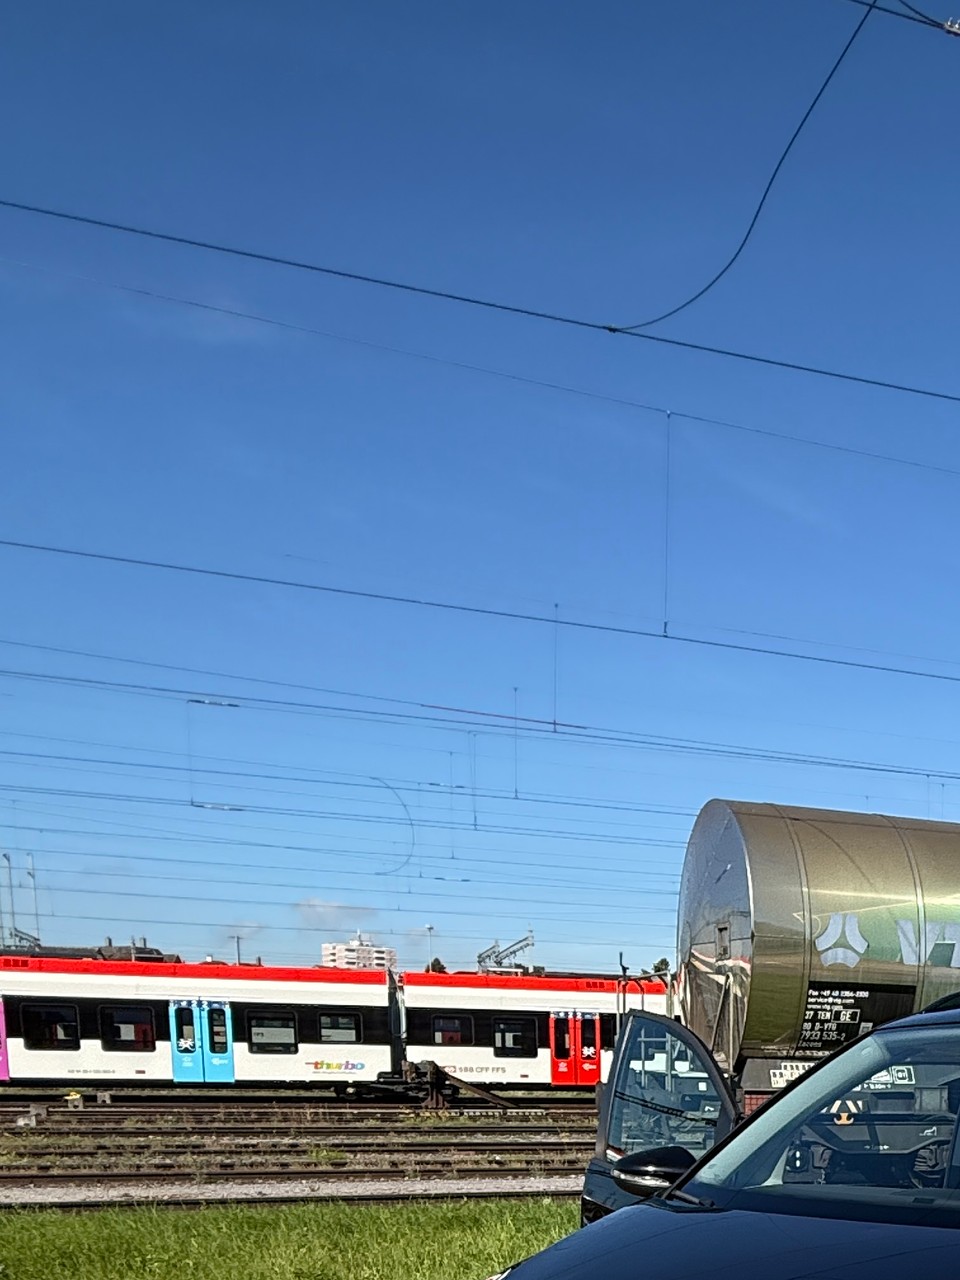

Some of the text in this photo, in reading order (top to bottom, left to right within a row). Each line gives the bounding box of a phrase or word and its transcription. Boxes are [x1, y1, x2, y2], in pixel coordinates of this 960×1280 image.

[804, 1010, 853, 1022] 37 TEN GE
[800, 1030, 846, 1041] 7933 535-2
[305, 1060, 366, 1071] thurbo
